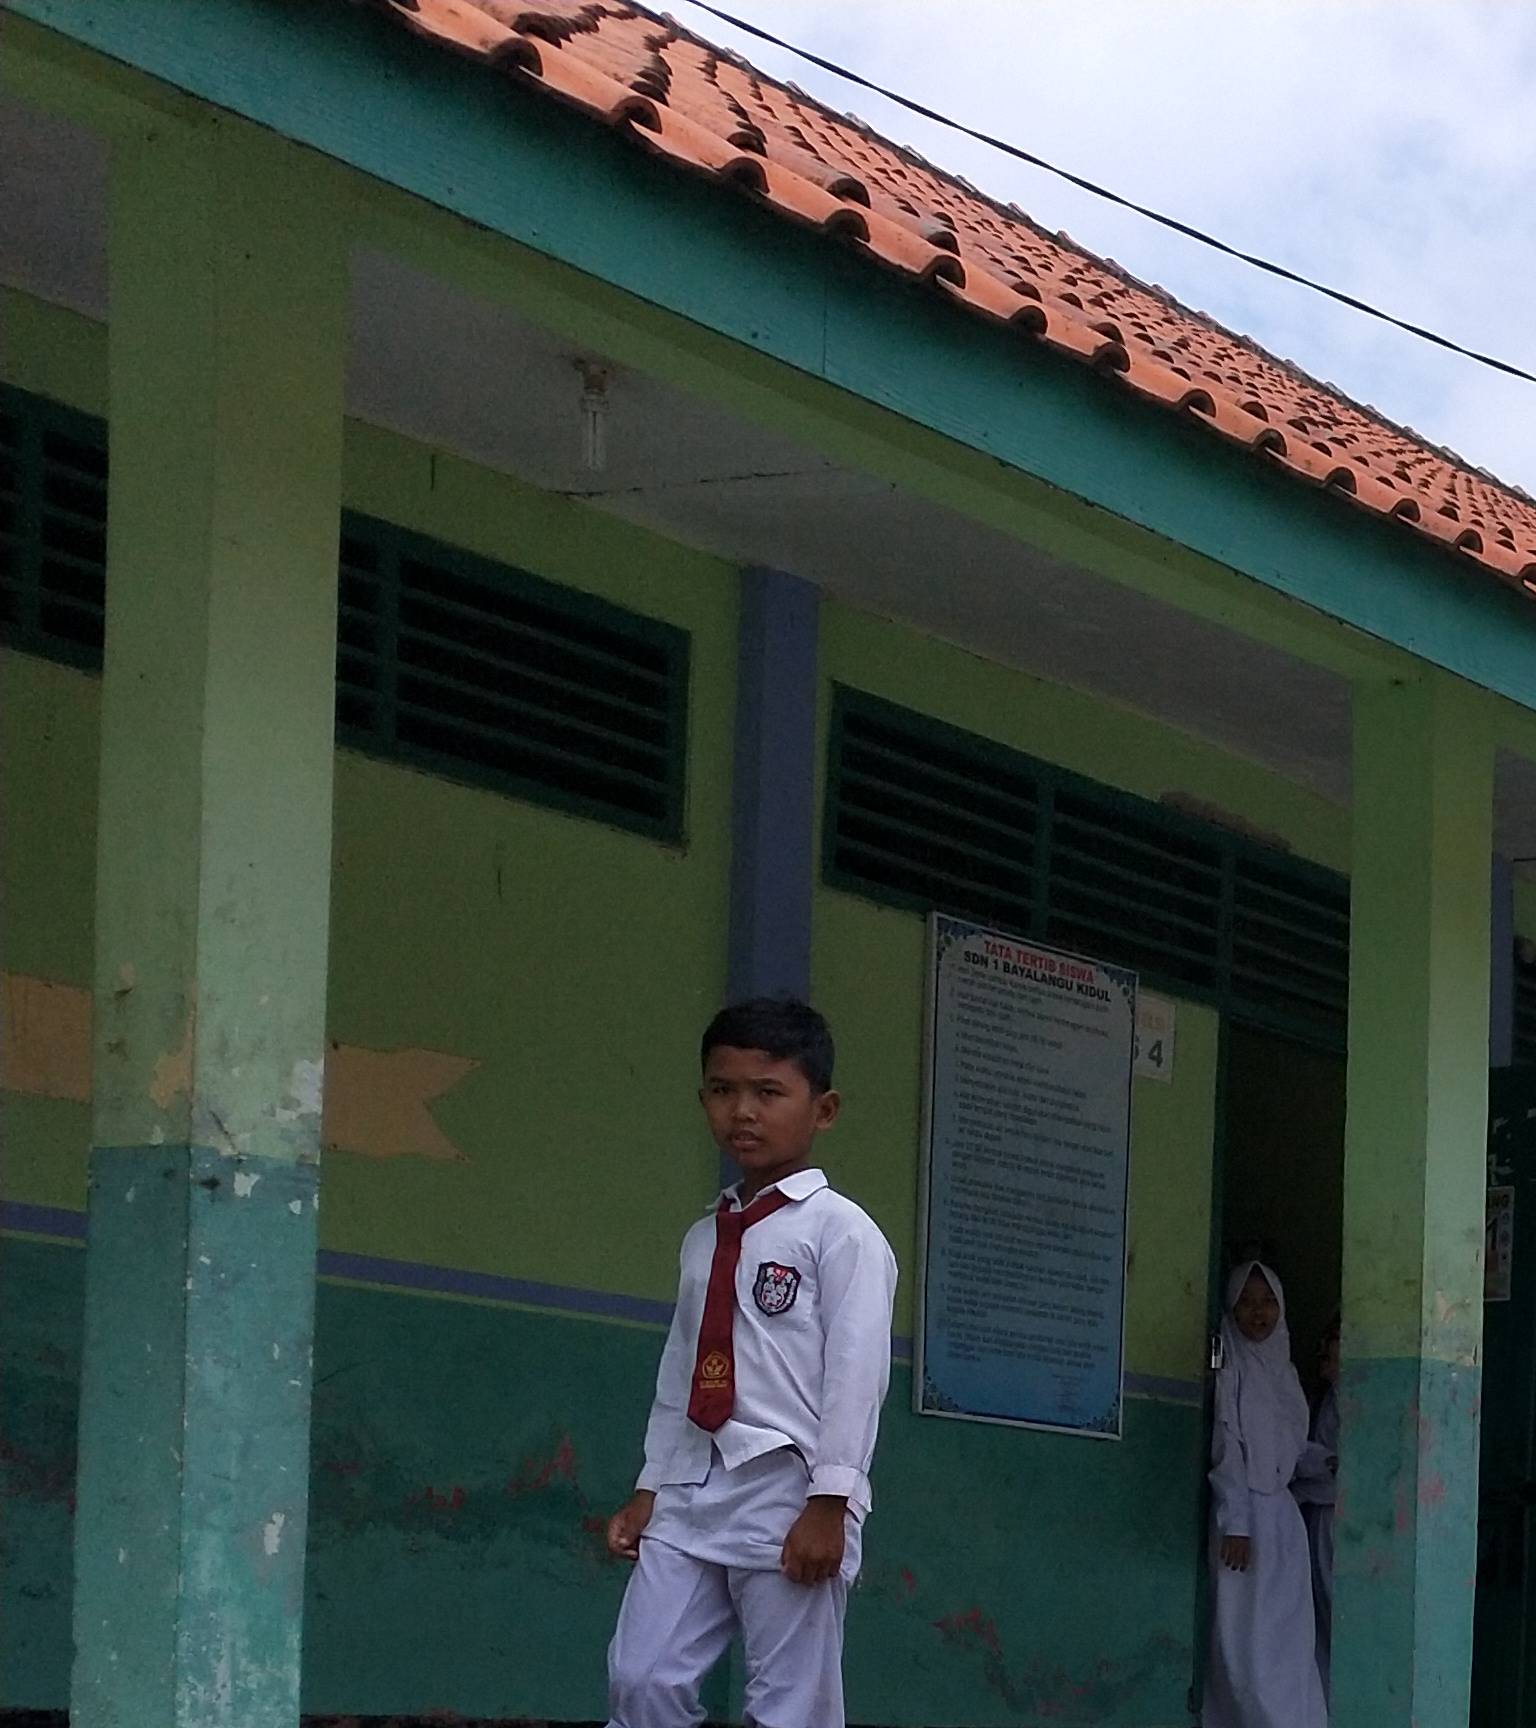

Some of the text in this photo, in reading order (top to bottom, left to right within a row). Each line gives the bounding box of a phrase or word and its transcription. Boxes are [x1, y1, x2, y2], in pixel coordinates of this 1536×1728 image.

[963, 950, 1112, 1003] SDN 1 BAYALANGU KIDUL
[984, 941, 1095, 984] TATA TERTIB SISWA
[1148, 1039, 1164, 1068] 4
